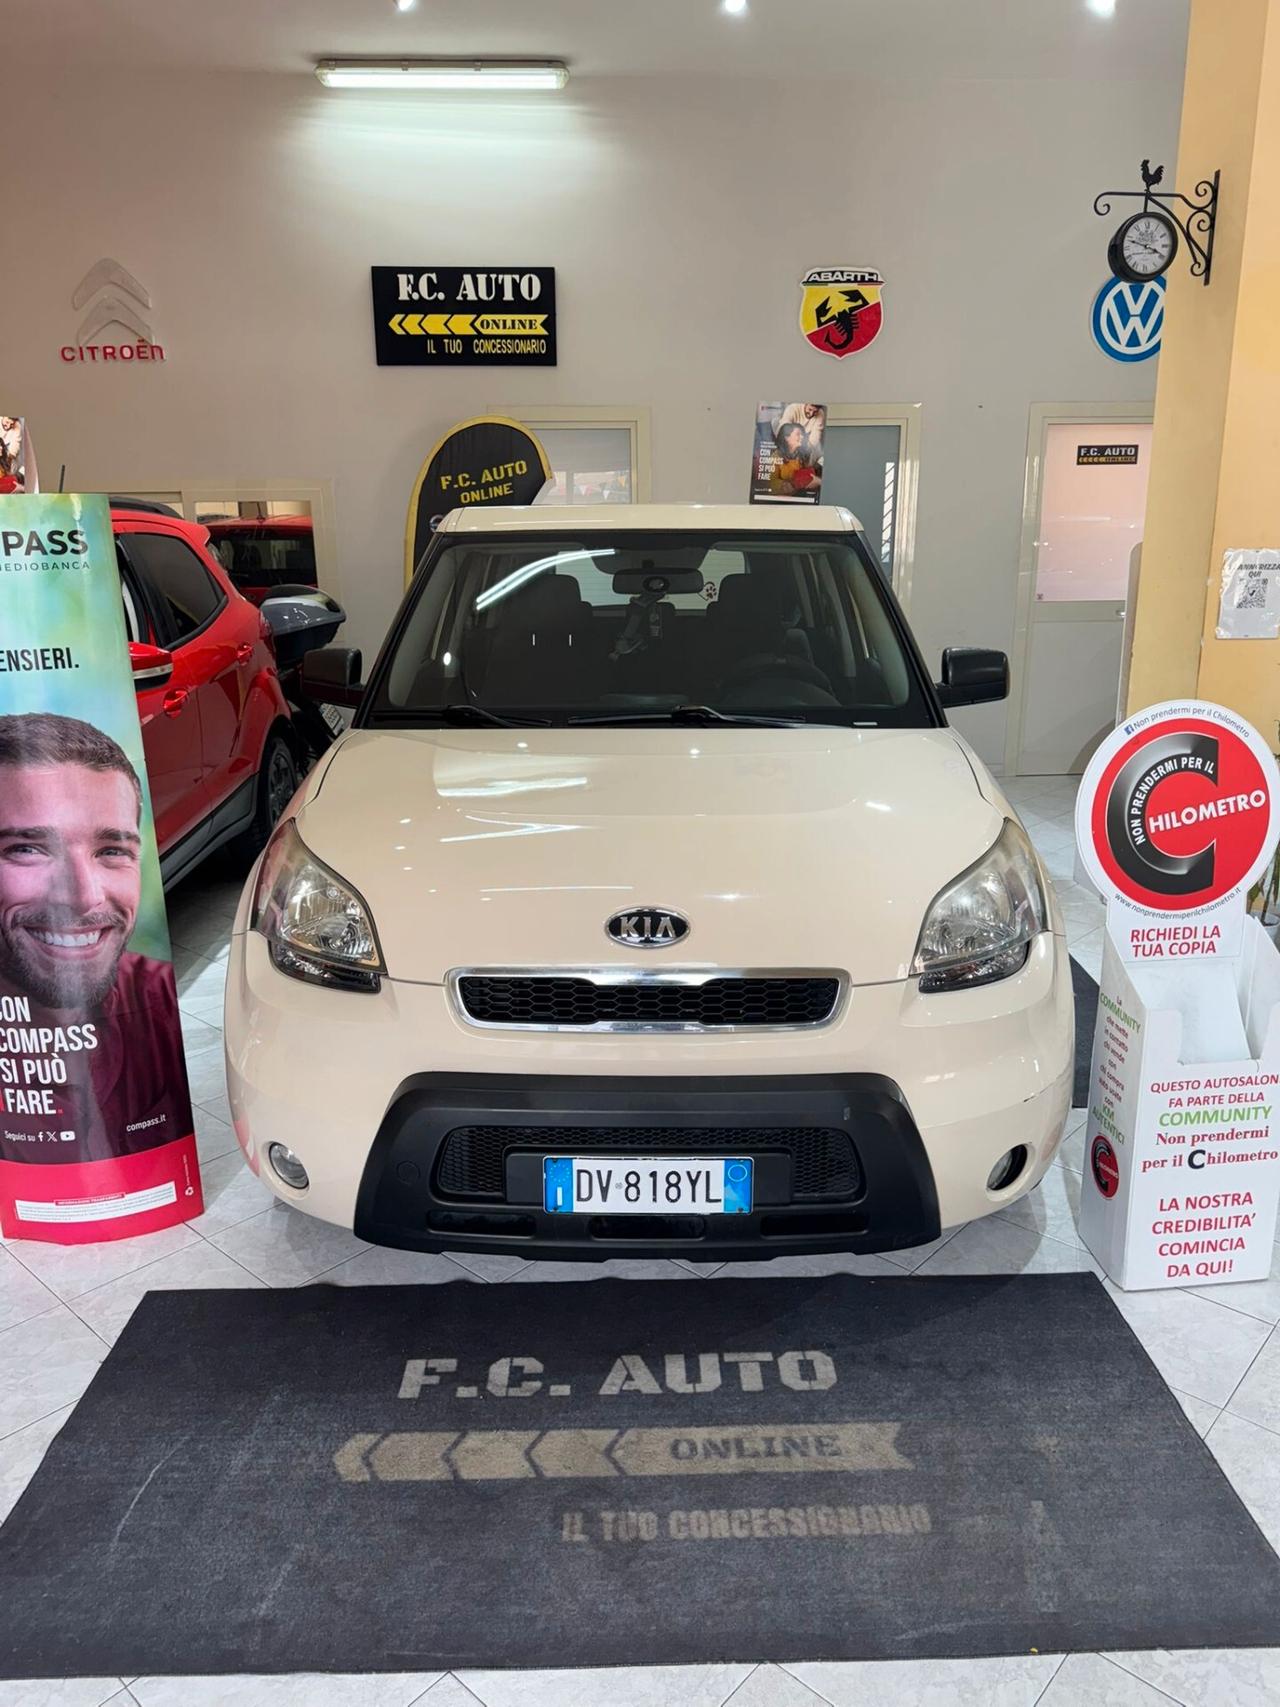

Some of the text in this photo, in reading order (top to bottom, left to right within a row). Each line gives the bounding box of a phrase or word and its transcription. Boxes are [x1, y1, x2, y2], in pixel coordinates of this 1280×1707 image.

[397, 273, 541, 300] F.C. AUTO
[808, 271, 877, 281] ABARTH
[480, 319, 537, 330] ONLINE
[427, 338, 547, 354] IL TUO CONCESSIONARIO
[1081, 447, 1135, 456] F.C. AUTO
[441, 460, 527, 490] F.C. AUTO
[460, 482, 514, 503] ONLINE
[0, 561, 90, 571] EDIOBANCA
[1134, 707, 1250, 738] Non prendermi per il Chilometro
[1130, 757, 1214, 845] NON PRENDERMI PER IL
[620, 916, 676, 937] KIA
[1130, 925, 1221, 942] RICHIEDI LA
[1132, 941, 1216, 958] TUA COPIA
[0, 996, 31, 1022] ON
[1100, 992, 1141, 1033] COMMUNITY
[0, 1053, 67, 1084] SI PUÒ
[1151, 1080, 1201, 1094] QUESTO
[1168, 1092, 1264, 1108] FA PARTE DELLA
[126, 1114, 167, 1132] compass.it
[1092, 1106, 1125, 1145] AUTENTICI
[1159, 1105, 1272, 1127] COMMUNITY
[4, 1130, 26, 1141] Seguici
[1156, 1125, 1269, 1146] Non prendermi
[1142, 1149, 1278, 1172] per il Chilometro
[1159, 1192, 1253, 1212] LA NOSTRA
[1152, 1213, 1256, 1234] CREDIBILITA'
[1158, 1237, 1245, 1256] COMINCIA
[1167, 1259, 1233, 1278] DA QUI!
[397, 1350, 838, 1399] F.C. AUTO
[669, 1434, 842, 1461] ONLINE
[561, 1503, 932, 1542] IL TUO CONCESSIONARIO
